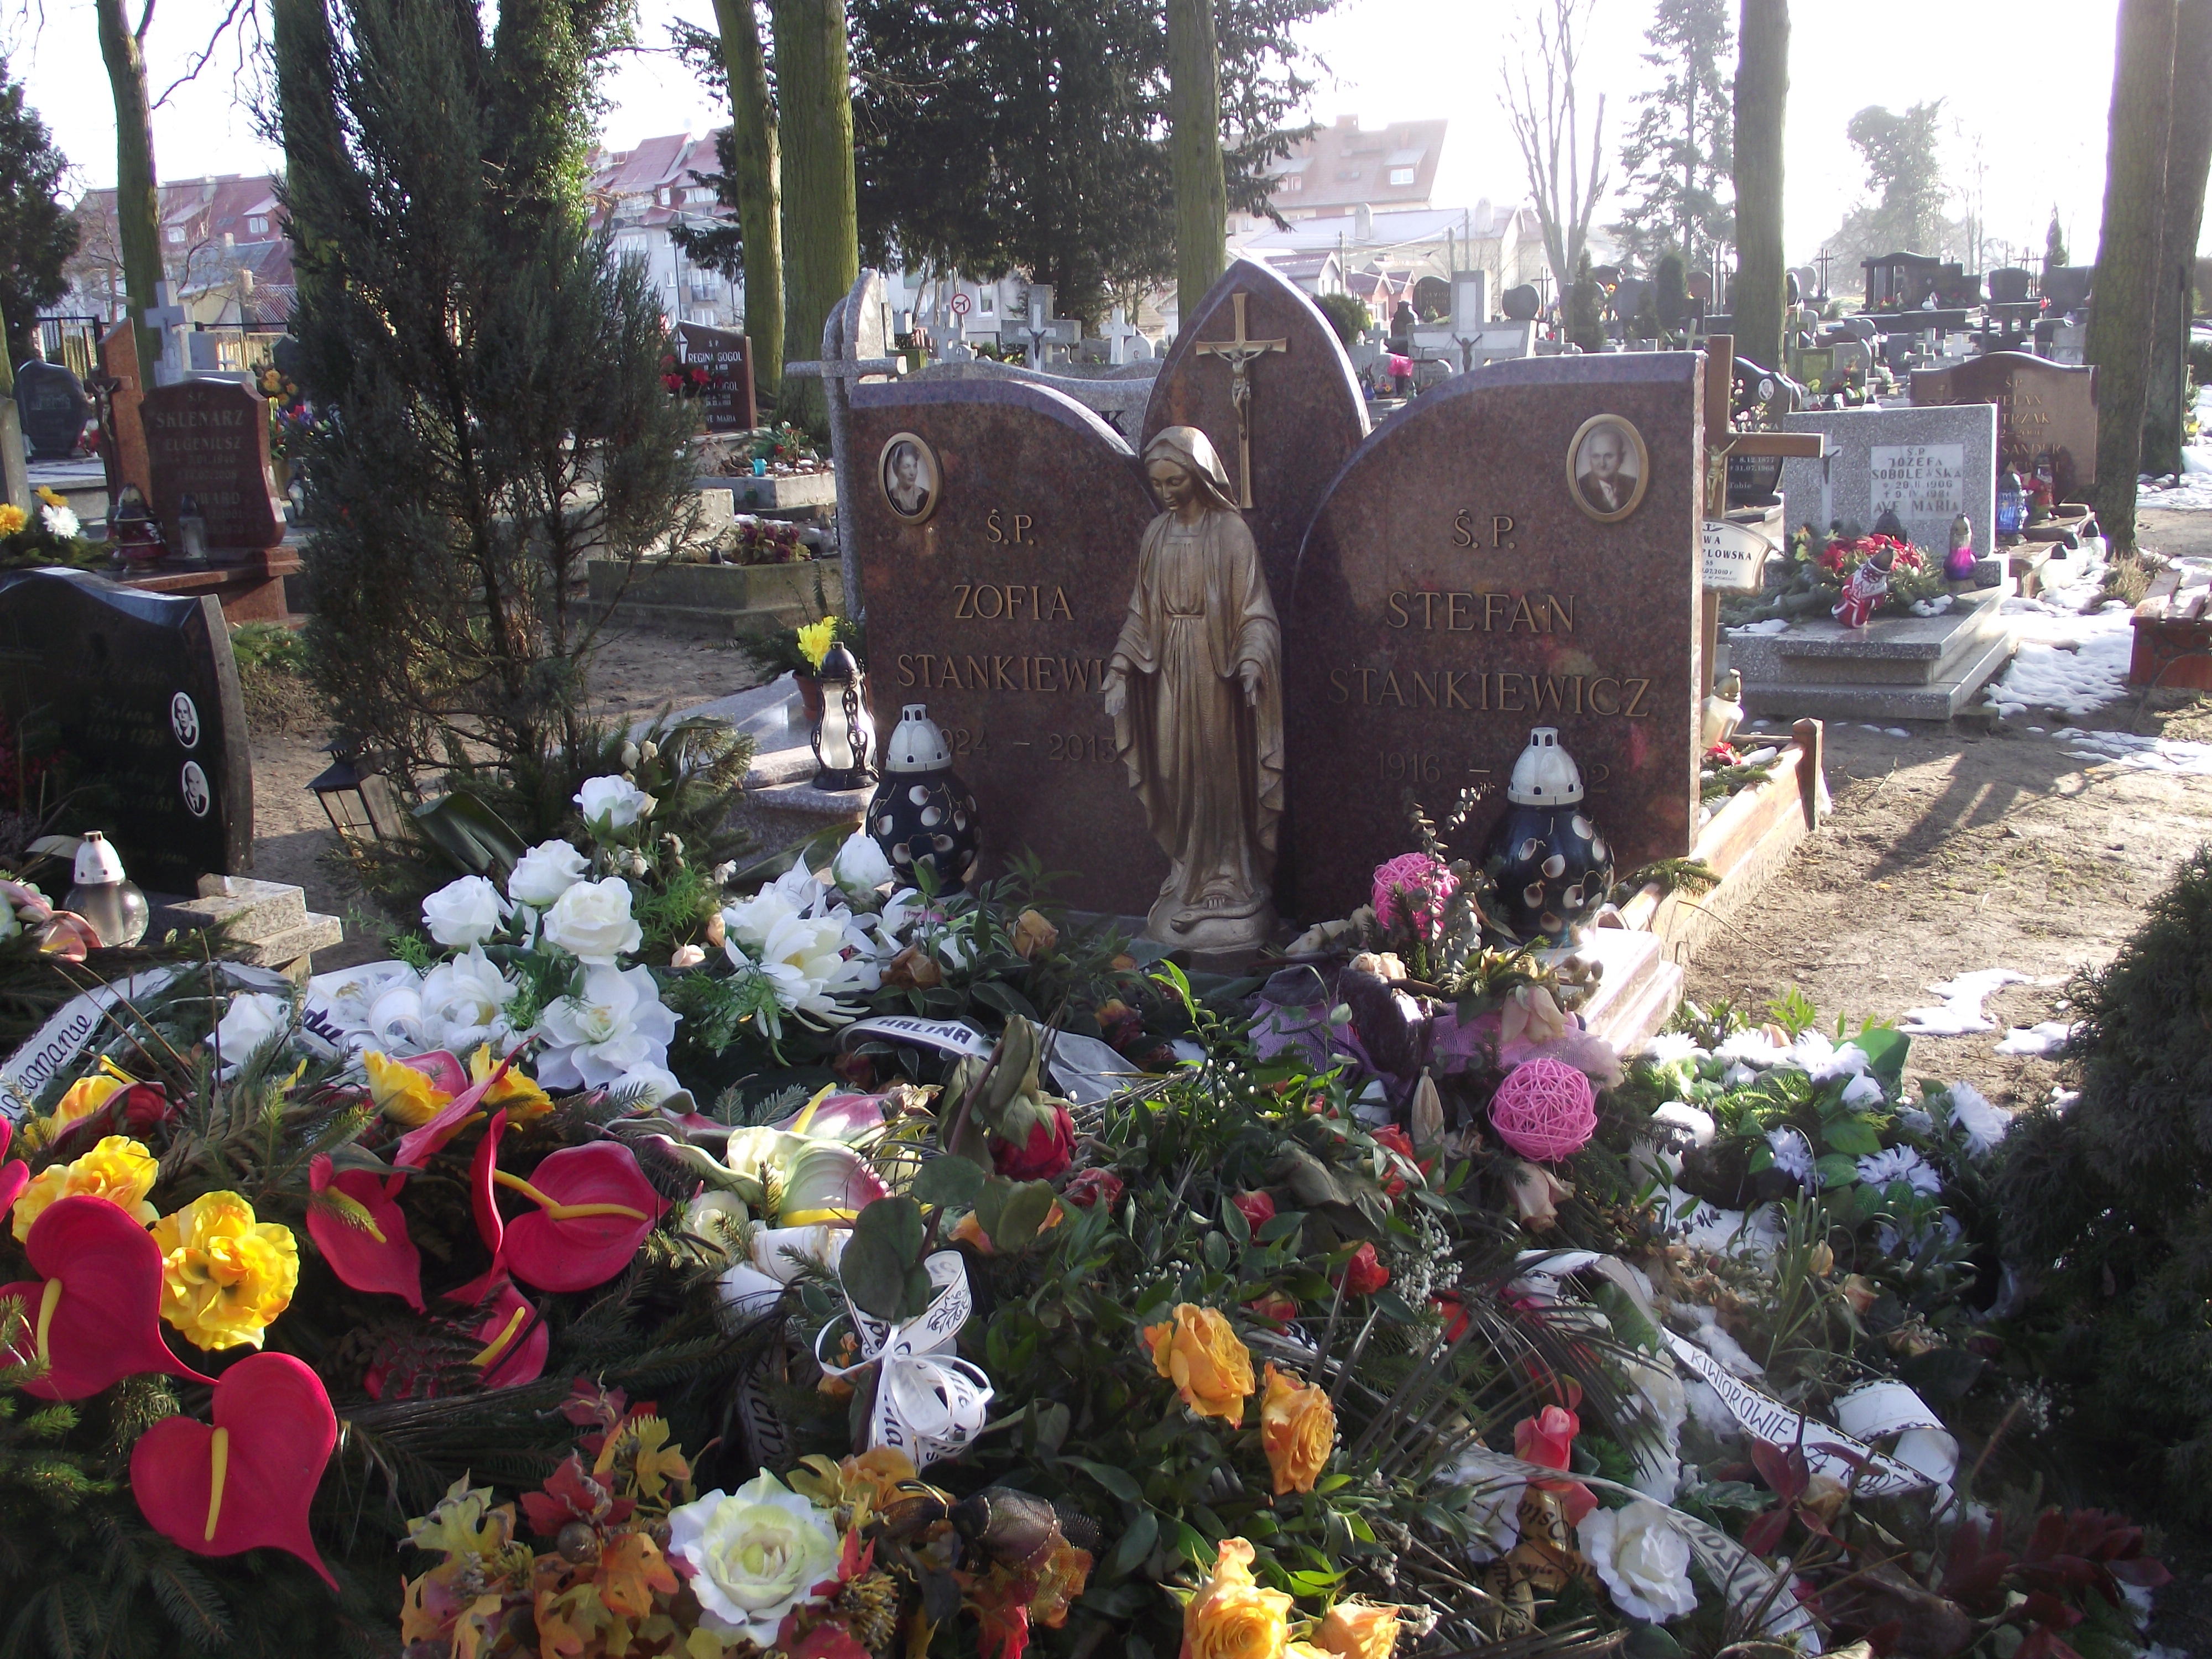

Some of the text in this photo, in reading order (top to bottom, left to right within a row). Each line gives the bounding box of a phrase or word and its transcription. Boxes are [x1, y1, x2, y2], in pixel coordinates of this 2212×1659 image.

[688, 351, 743, 363] REGINA GOGOL
[156, 408, 244, 429] SKLENARZ
[165, 435, 241, 452] EUGENIUSZ
[1871, 468, 1961, 480] SOBOLEWSKA
[1912, 500, 1959, 512] MARIA
[953, 585, 1074, 621] ZOFIA
[1386, 592, 1575, 633] STEFAN
[896, 654, 1105, 693] STANKIEWI
[1329, 668, 1652, 717] STANKIEWICZ
[941, 727, 990, 756] 924
[1375, 750, 1441, 784] 1916
[878, 1019, 973, 1045] HALINA
